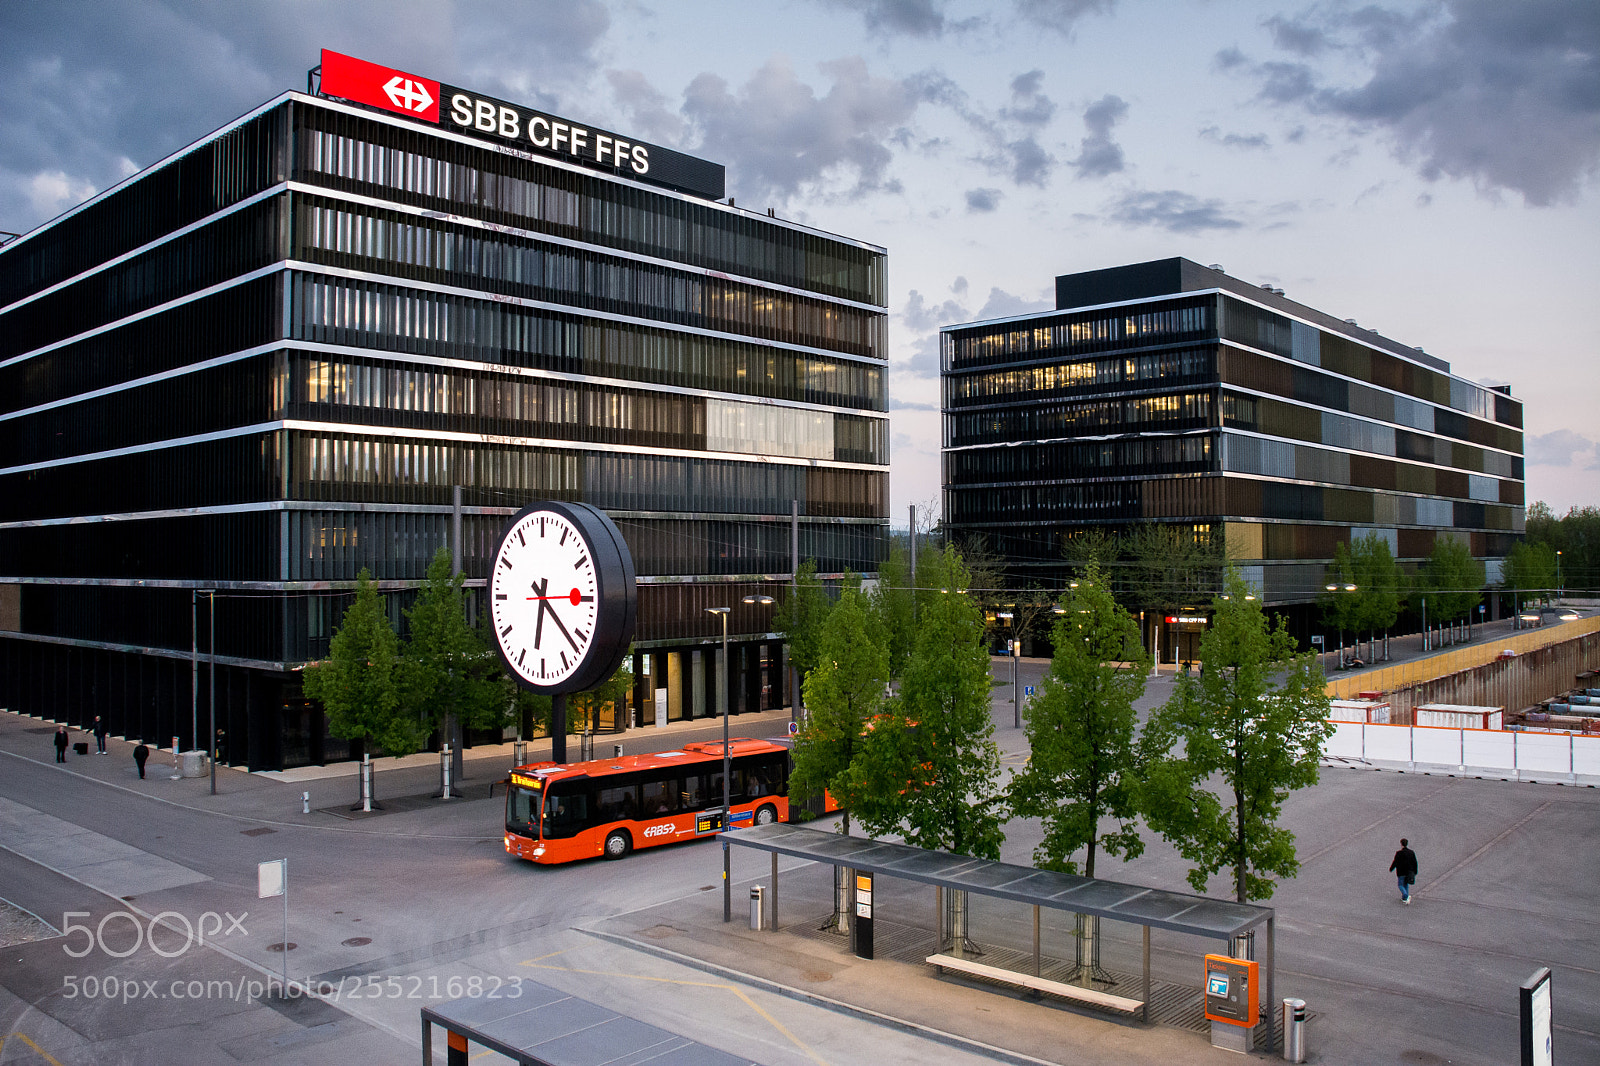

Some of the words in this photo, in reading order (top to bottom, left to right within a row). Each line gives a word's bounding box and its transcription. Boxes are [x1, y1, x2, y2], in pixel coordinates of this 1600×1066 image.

[449, 94, 520, 139] SBB
[527, 116, 588, 156] CFF
[596, 135, 649, 175] FFS
[648, 823, 671, 837] RBS
